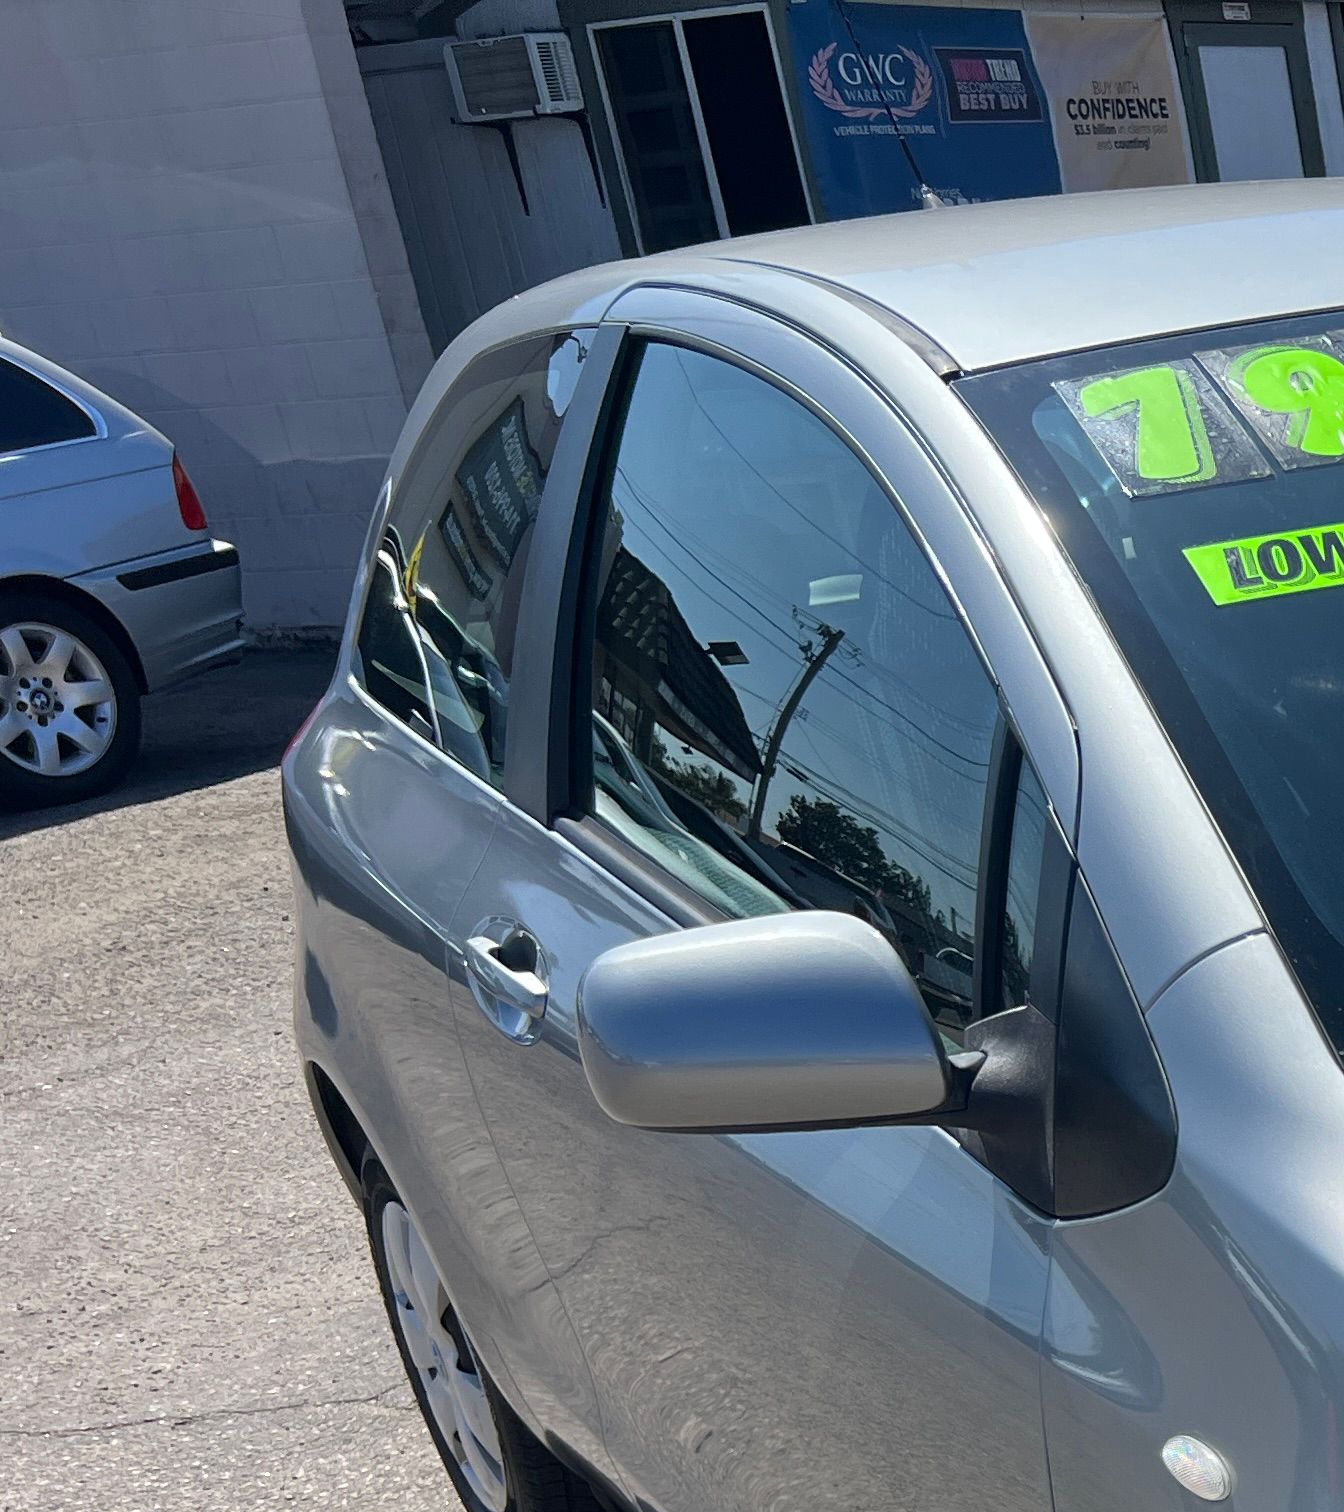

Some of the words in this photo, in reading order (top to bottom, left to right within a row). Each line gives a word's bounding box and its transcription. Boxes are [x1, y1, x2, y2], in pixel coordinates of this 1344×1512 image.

[838, 53, 905, 86] GWC
[956, 82, 1026, 94] RECOMMENDED
[1092, 80, 1112, 95] BUY
[1115, 81, 1140, 95] WITH
[959, 94, 995, 110] BEST
[1000, 93, 1028, 110] BUY
[1066, 98, 1169, 120] CONFIDENCE
[833, 125, 869, 136] VEHICLE
